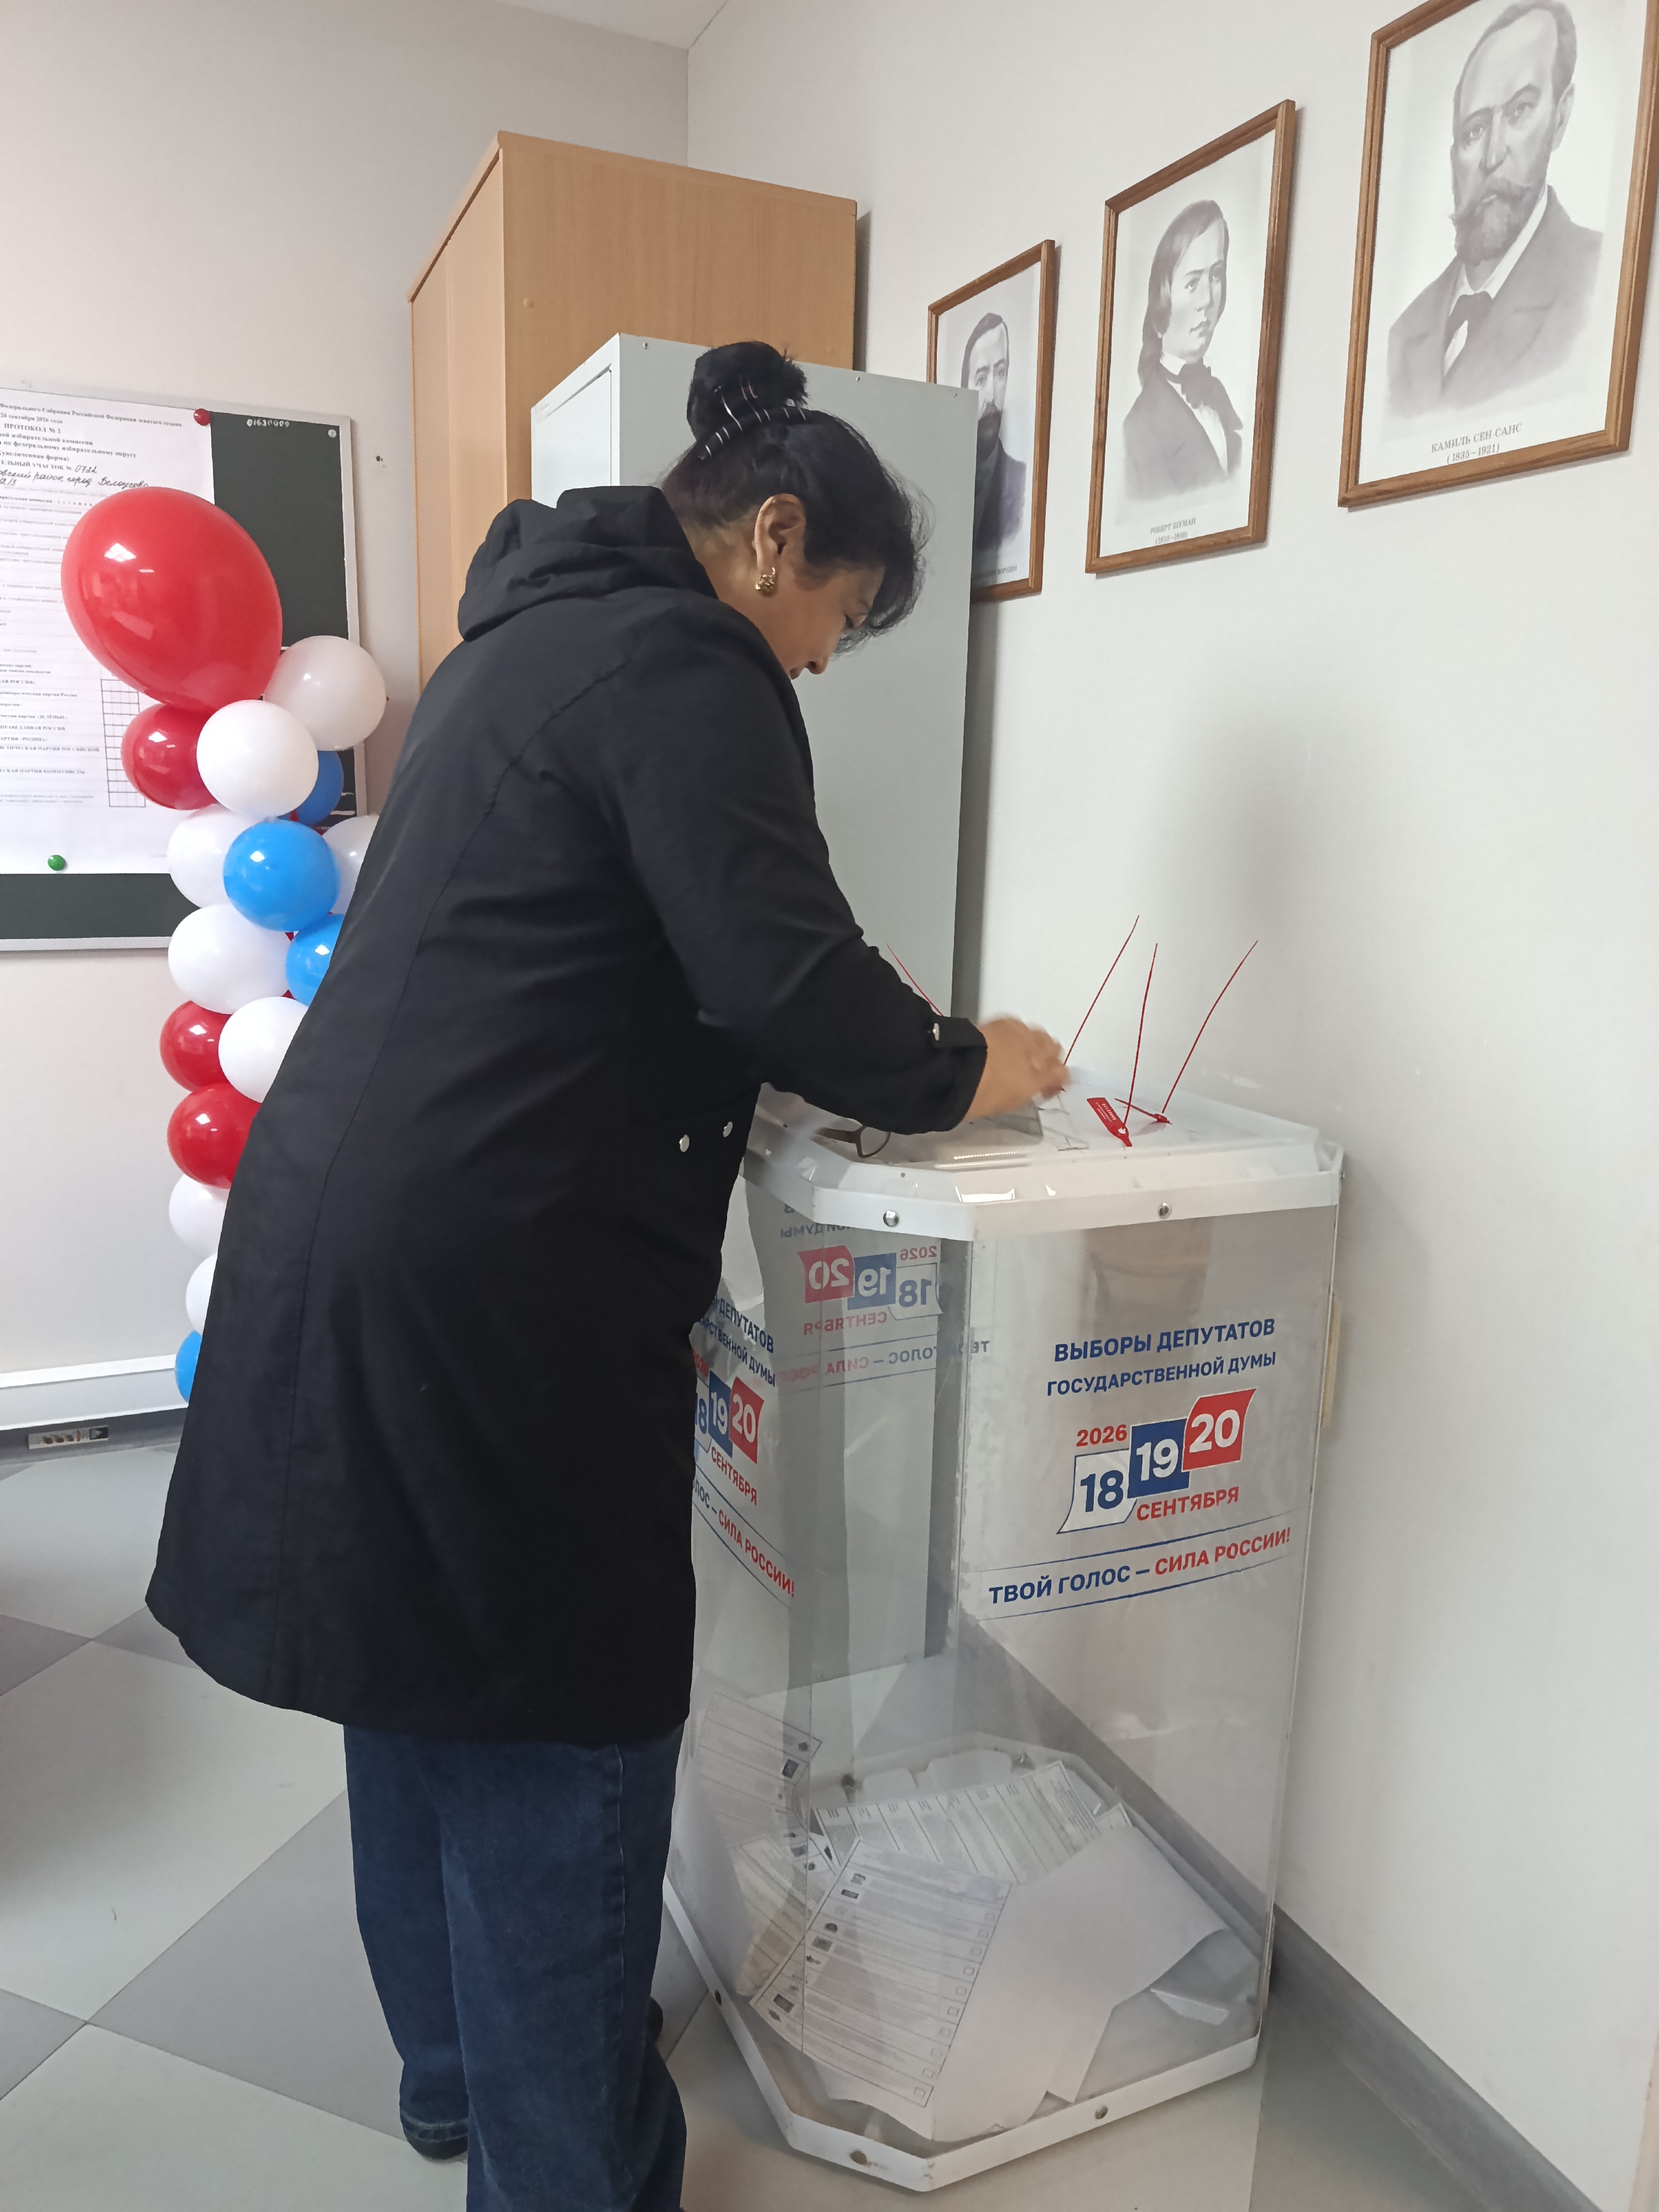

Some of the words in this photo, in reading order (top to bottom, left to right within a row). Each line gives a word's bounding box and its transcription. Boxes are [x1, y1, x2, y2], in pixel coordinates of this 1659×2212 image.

[4, 423, 46, 432] ПРОТОКОЛ
[12, 433, 60, 443] избирательной
[1431, 433, 1471, 453] КАМИЛЬ
[13, 441, 59, 451] федеральному
[62, 446, 113, 457] избирательному
[1150, 523, 1172, 535] РОБЕРТ
[1172, 517, 1196, 529] ШУМАН
[719, 1297, 774, 1354] ДЕПУТАТОВ
[1054, 1333, 1152, 1362] ВЫБОРЫ
[1156, 1318, 1276, 1353] ДЕПУТАТОВ
[749, 1355, 775, 1387] ДУМЫ
[1047, 1356, 1225, 1396] ГОСУДАРСТВЕННОЙ
[1228, 1352, 1277, 1375] ДУМЫ
[711, 1391, 728, 1435] 19
[731, 1393, 756, 1443] 20
[1076, 1423, 1128, 1447] 2026
[711, 1446, 758, 1506] СЕНТЯБРЯ
[1079, 1469, 1124, 1512] 18
[1135, 1437, 1180, 1481] 19
[1188, 1408, 1241, 1453] 20
[1136, 1485, 1240, 1521] СЕНТЯБРЯ
[719, 1509, 743, 1549] СИЛА
[745, 1537, 795, 1599] РОССИИ!
[988, 1576, 1052, 1604] ТВОЙ
[1058, 1565, 1131, 1595] ГОЛОС
[1155, 1548, 1210, 1576] СИЛА
[1214, 1527, 1291, 1563] РОССИИ!
